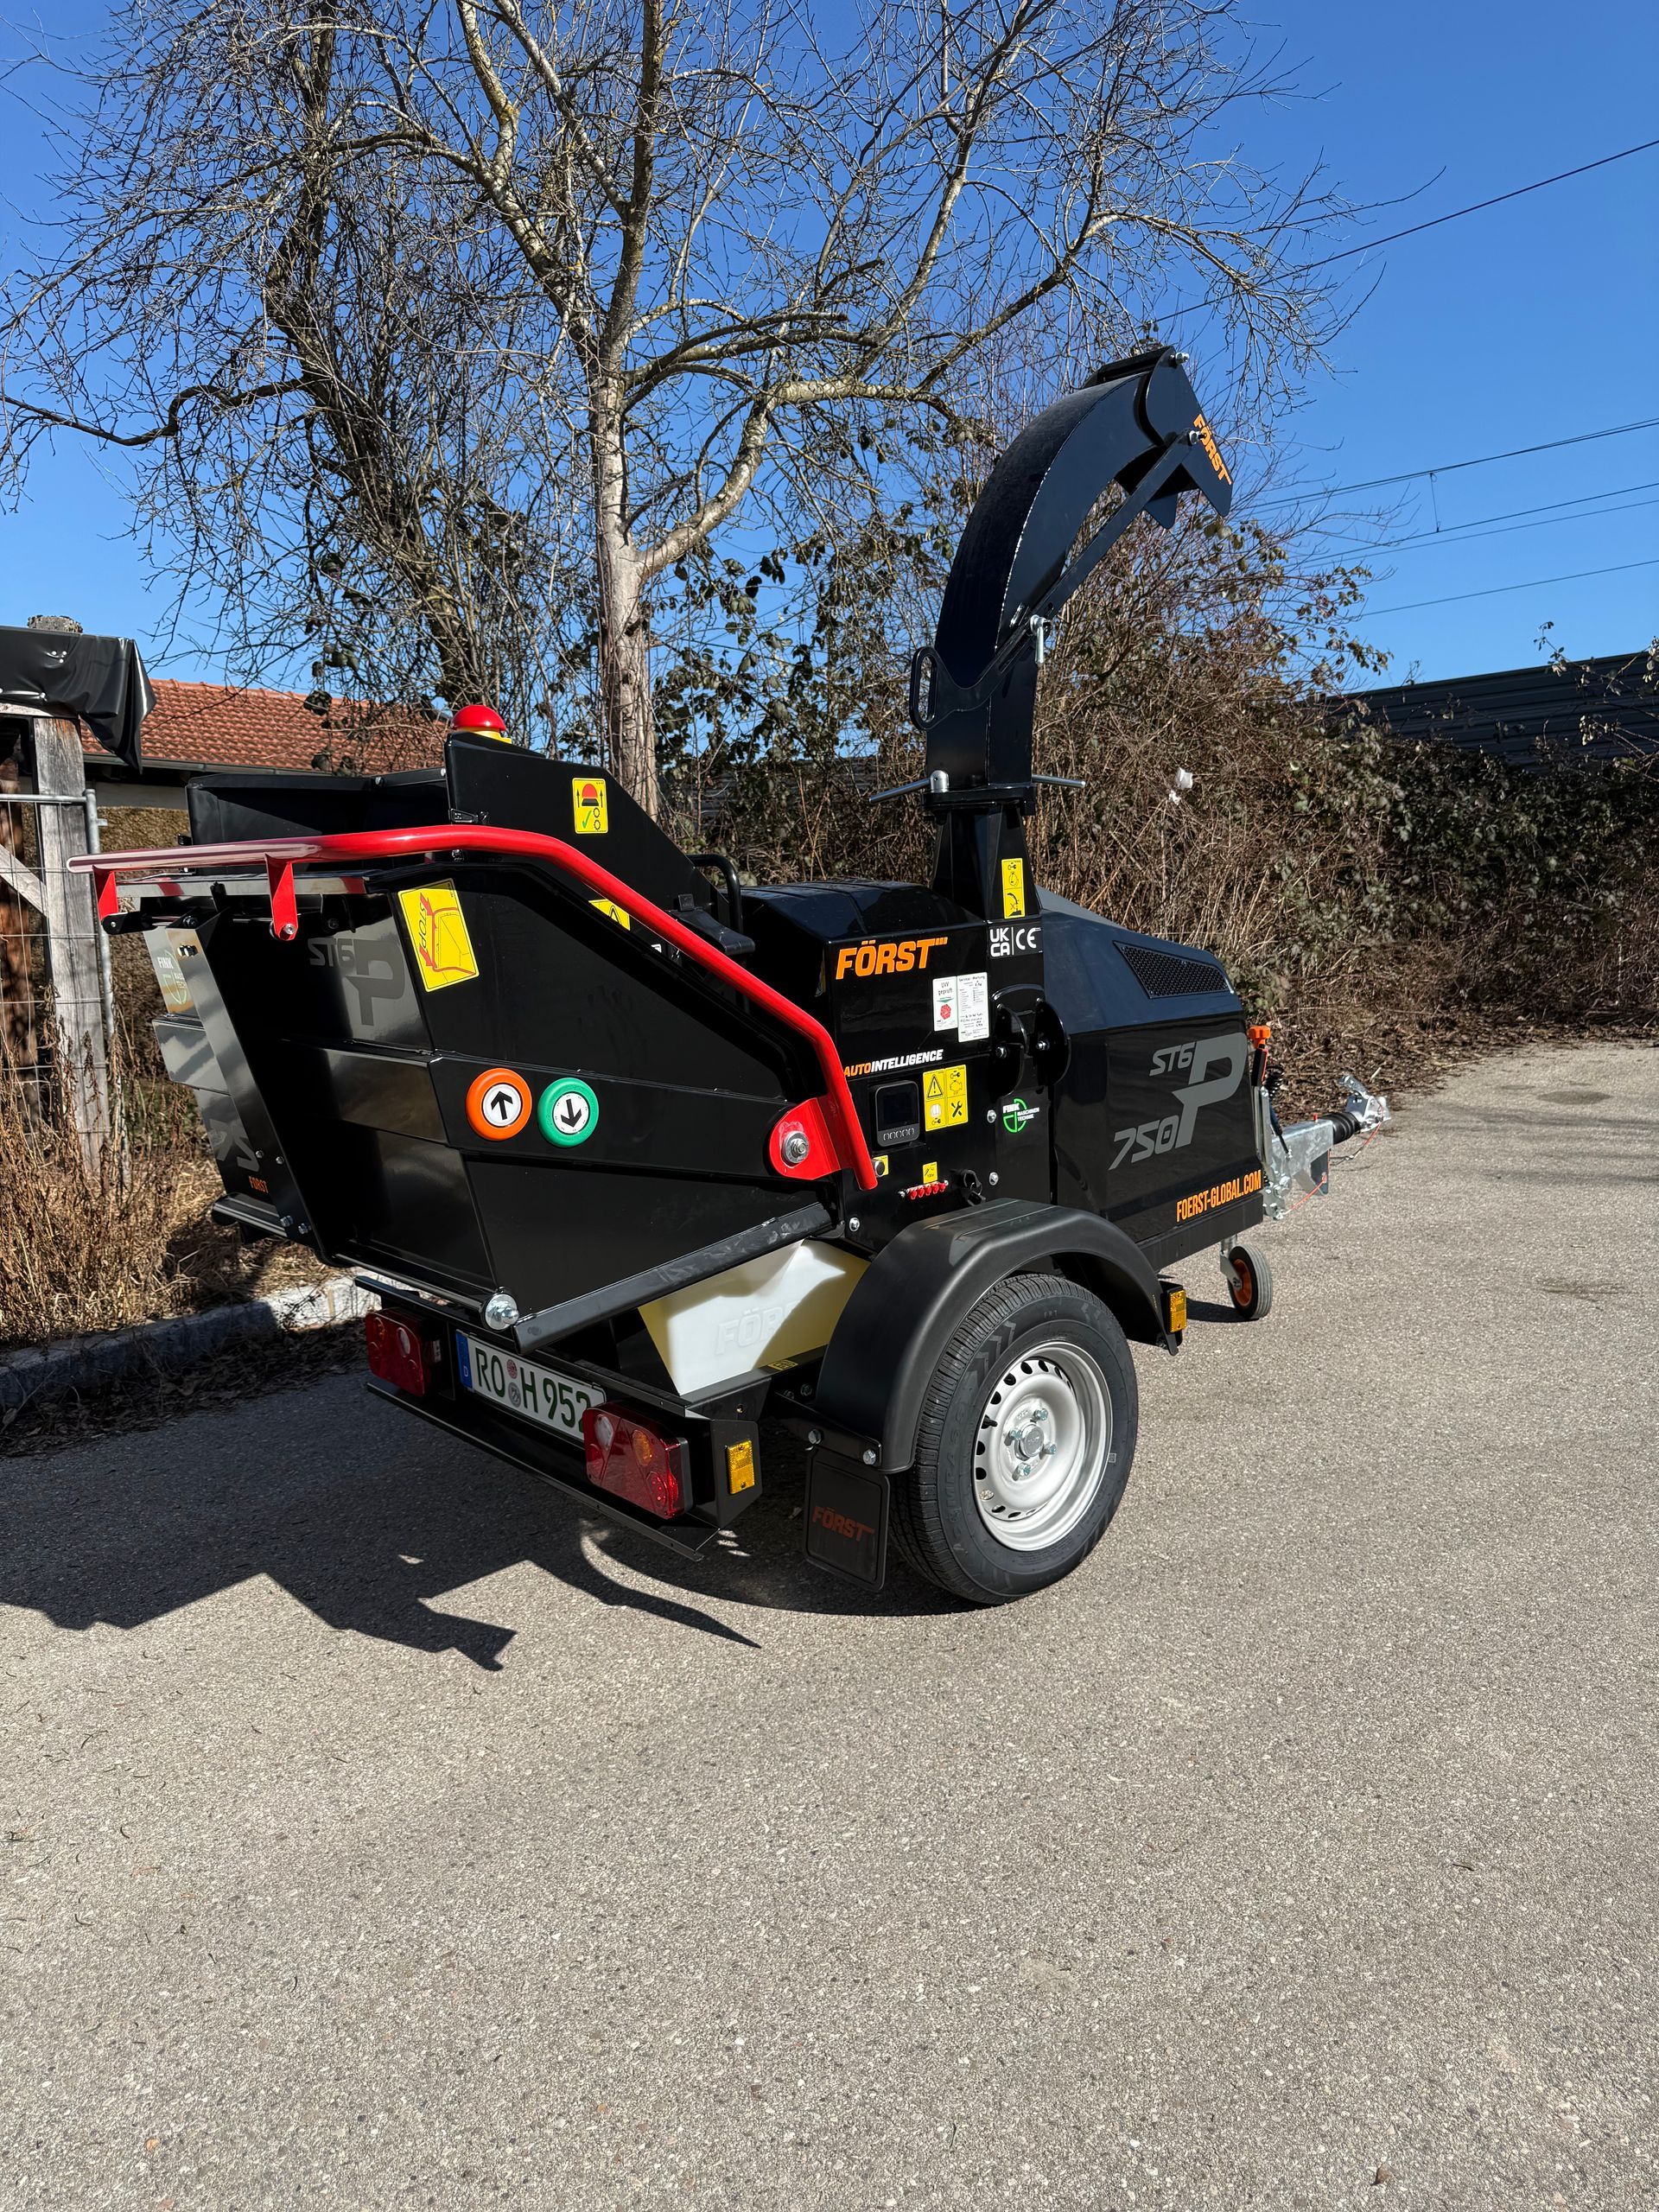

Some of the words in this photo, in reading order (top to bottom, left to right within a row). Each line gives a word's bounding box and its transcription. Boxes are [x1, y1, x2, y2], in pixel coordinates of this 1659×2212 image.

[1193, 413, 1232, 486] FÖRST
[989, 927, 1010, 943] UK
[1015, 927, 1041, 950] CE
[836, 937, 949, 981] FÖRST
[990, 942, 1010, 957] CA
[843, 1049, 944, 1077] AUTOINTELLIGENCE
[1002, 1103, 1020, 1114] FINK
[1108, 1115, 1179, 1171] 750
[1176, 1169, 1262, 1223] FOERST-GLOBAL.COM
[463, 1365, 469, 1377] D
[475, 1346, 506, 1398] RO
[520, 1367, 538, 1414] H
